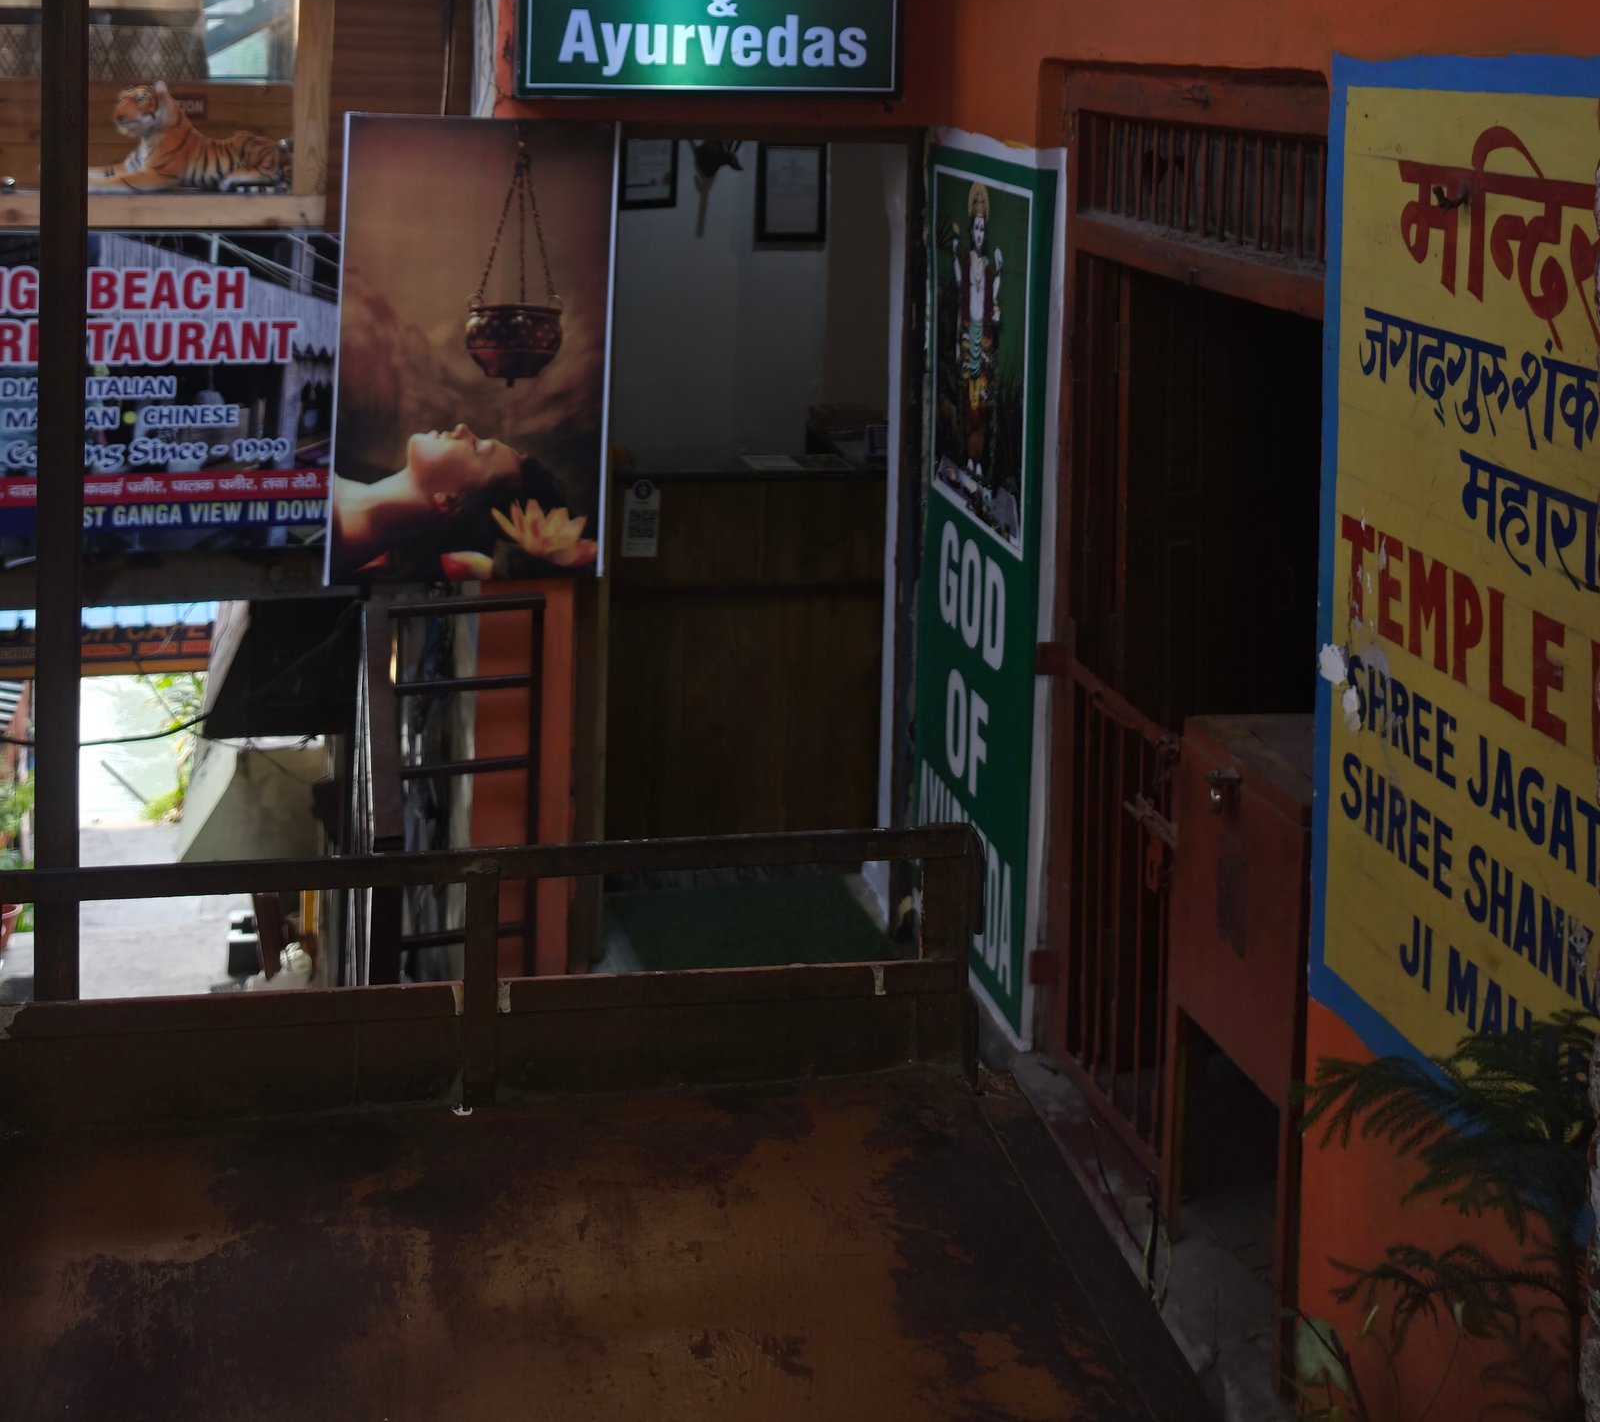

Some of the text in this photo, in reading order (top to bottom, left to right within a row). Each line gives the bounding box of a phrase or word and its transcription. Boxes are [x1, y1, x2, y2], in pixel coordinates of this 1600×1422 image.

[557, 8, 868, 77] Ayurvedas
[90, 271, 245, 310] BEACH
[0, 321, 297, 362] RTAURANT
[87, 378, 174, 396] ITALIAN
[144, 406, 238, 425] CHINESE
[131, 438, 206, 461] Since
[112, 503, 183, 527] GANGA
[189, 501, 243, 524] VIEW
[248, 500, 270, 522] IN
[1460, 449, 1600, 592] महारा
[939, 520, 1006, 671] GOD
[1341, 514, 1567, 746] TEMPLE
[945, 668, 989, 798] OF
[1347, 653, 1456, 790] SHREE
[1340, 752, 1453, 900] SHREE
[1400, 914, 1432, 994] JI
